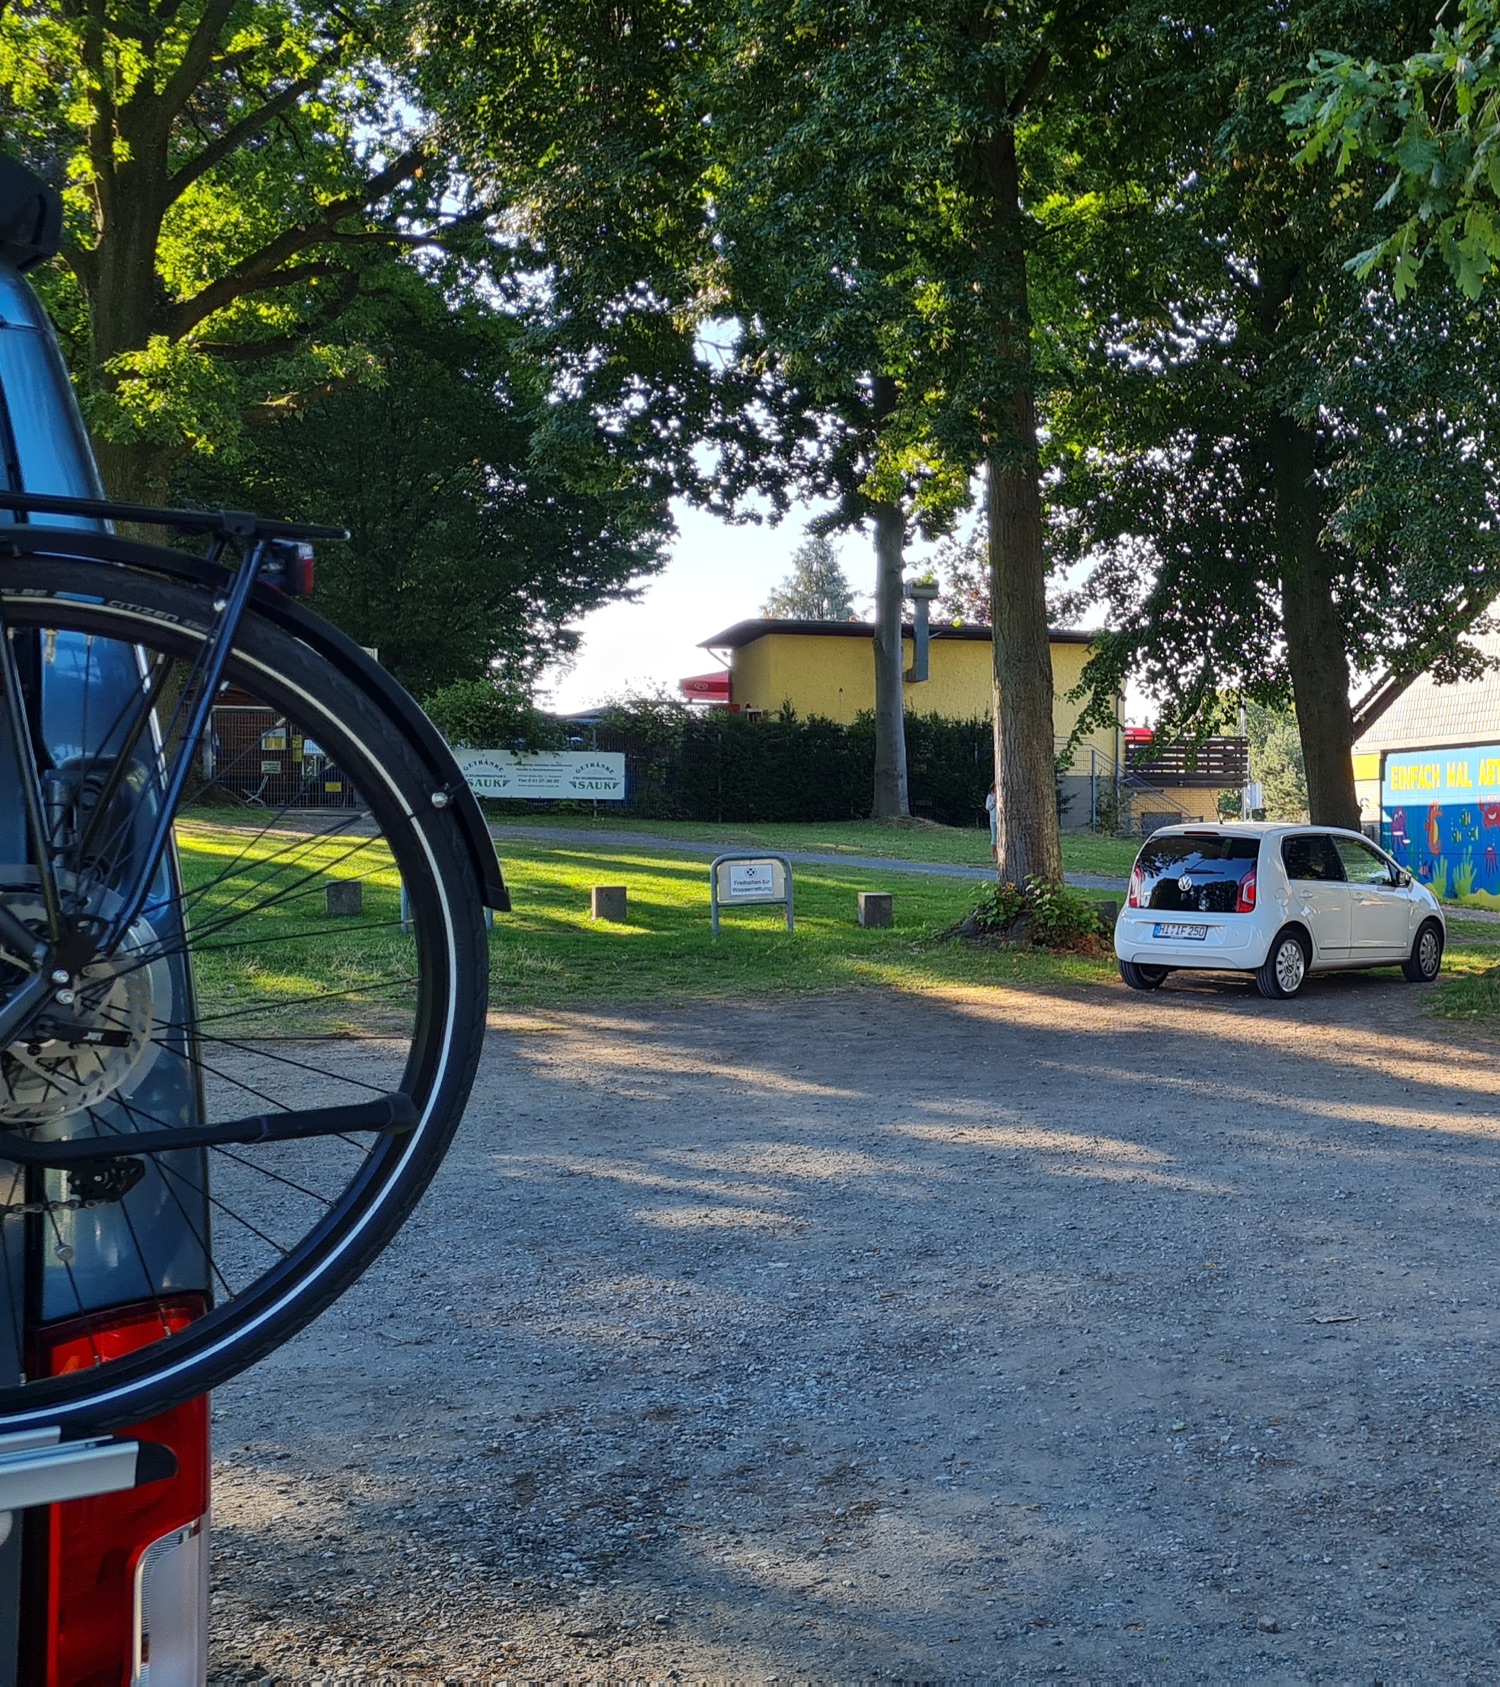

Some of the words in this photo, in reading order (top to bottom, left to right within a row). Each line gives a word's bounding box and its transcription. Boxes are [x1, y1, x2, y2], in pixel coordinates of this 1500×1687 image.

[108, 600, 180, 623] CITIZEN
[463, 757, 505, 772] GETRÄNKE
[575, 760, 615, 774] GETRÄNKE
[467, 779, 502, 788] SAUK
[1390, 763, 1441, 791] EINFACH
[1446, 762, 1473, 789] MAL
[577, 781, 612, 790] SAUK
[1188, 926, 1206, 937] 250
